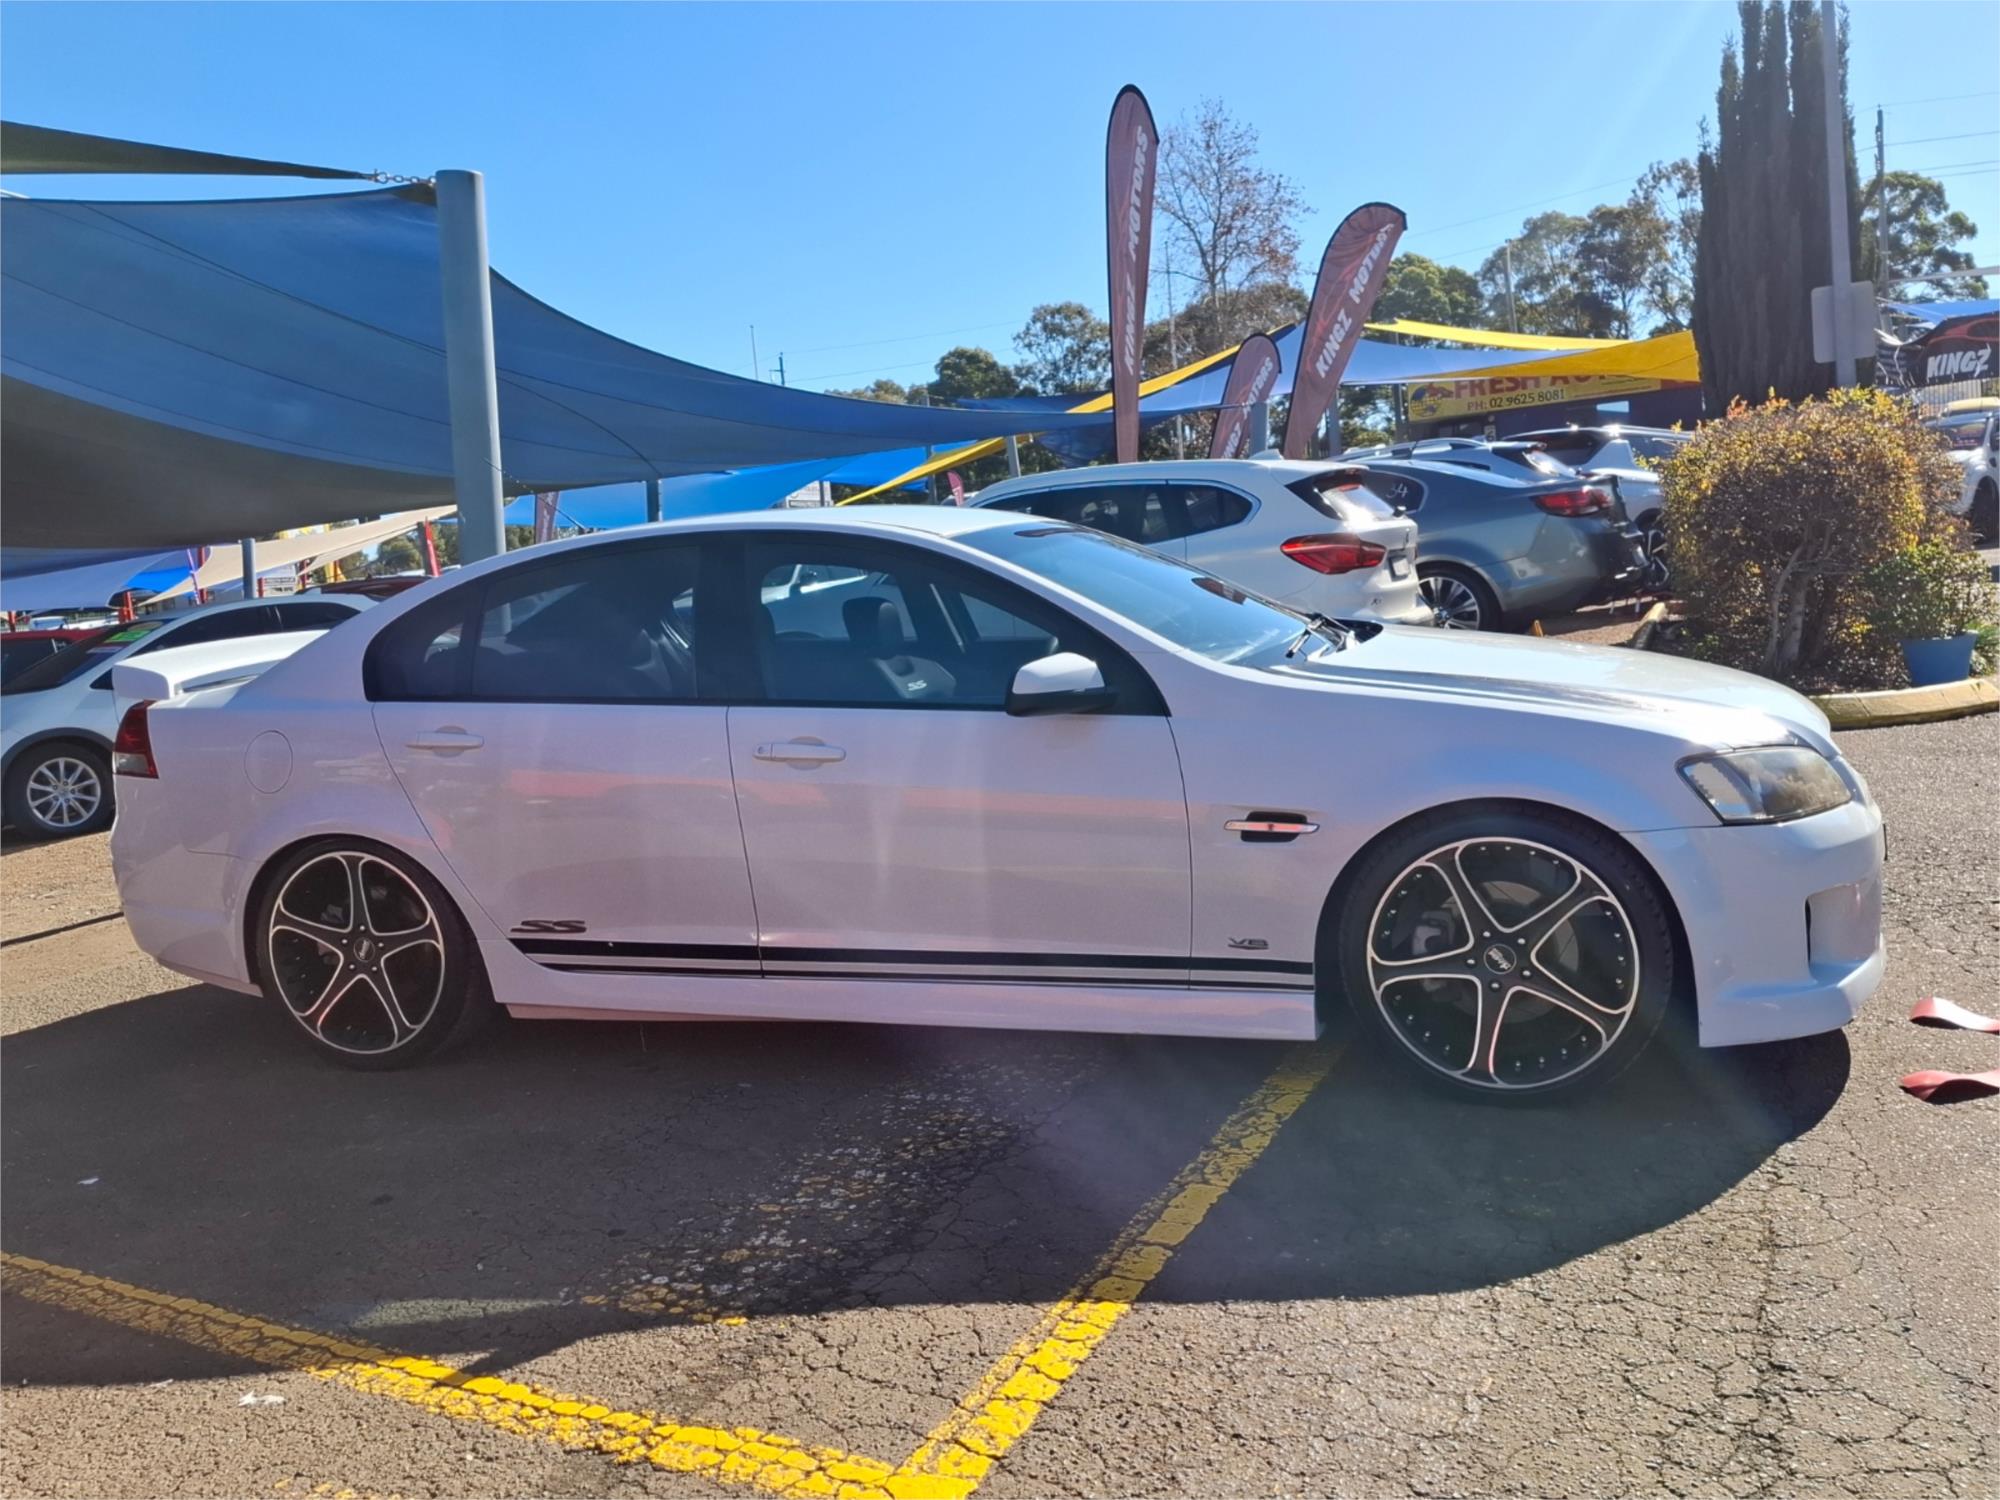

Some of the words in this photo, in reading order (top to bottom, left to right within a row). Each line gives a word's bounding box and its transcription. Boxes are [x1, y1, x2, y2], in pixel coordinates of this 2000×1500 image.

[1128, 126, 1149, 262] MOTORS
[1315, 308, 1352, 378] KINGZ
[1927, 349, 1990, 379] KINGZ
[1455, 376, 1540, 399] FRESH
[1467, 399, 1488, 411] PH:
[1489, 396, 1503, 408] 02
[1505, 392, 1535, 406] 9625
[1538, 389, 1565, 402] 8081
[510, 920, 587, 933] SS
